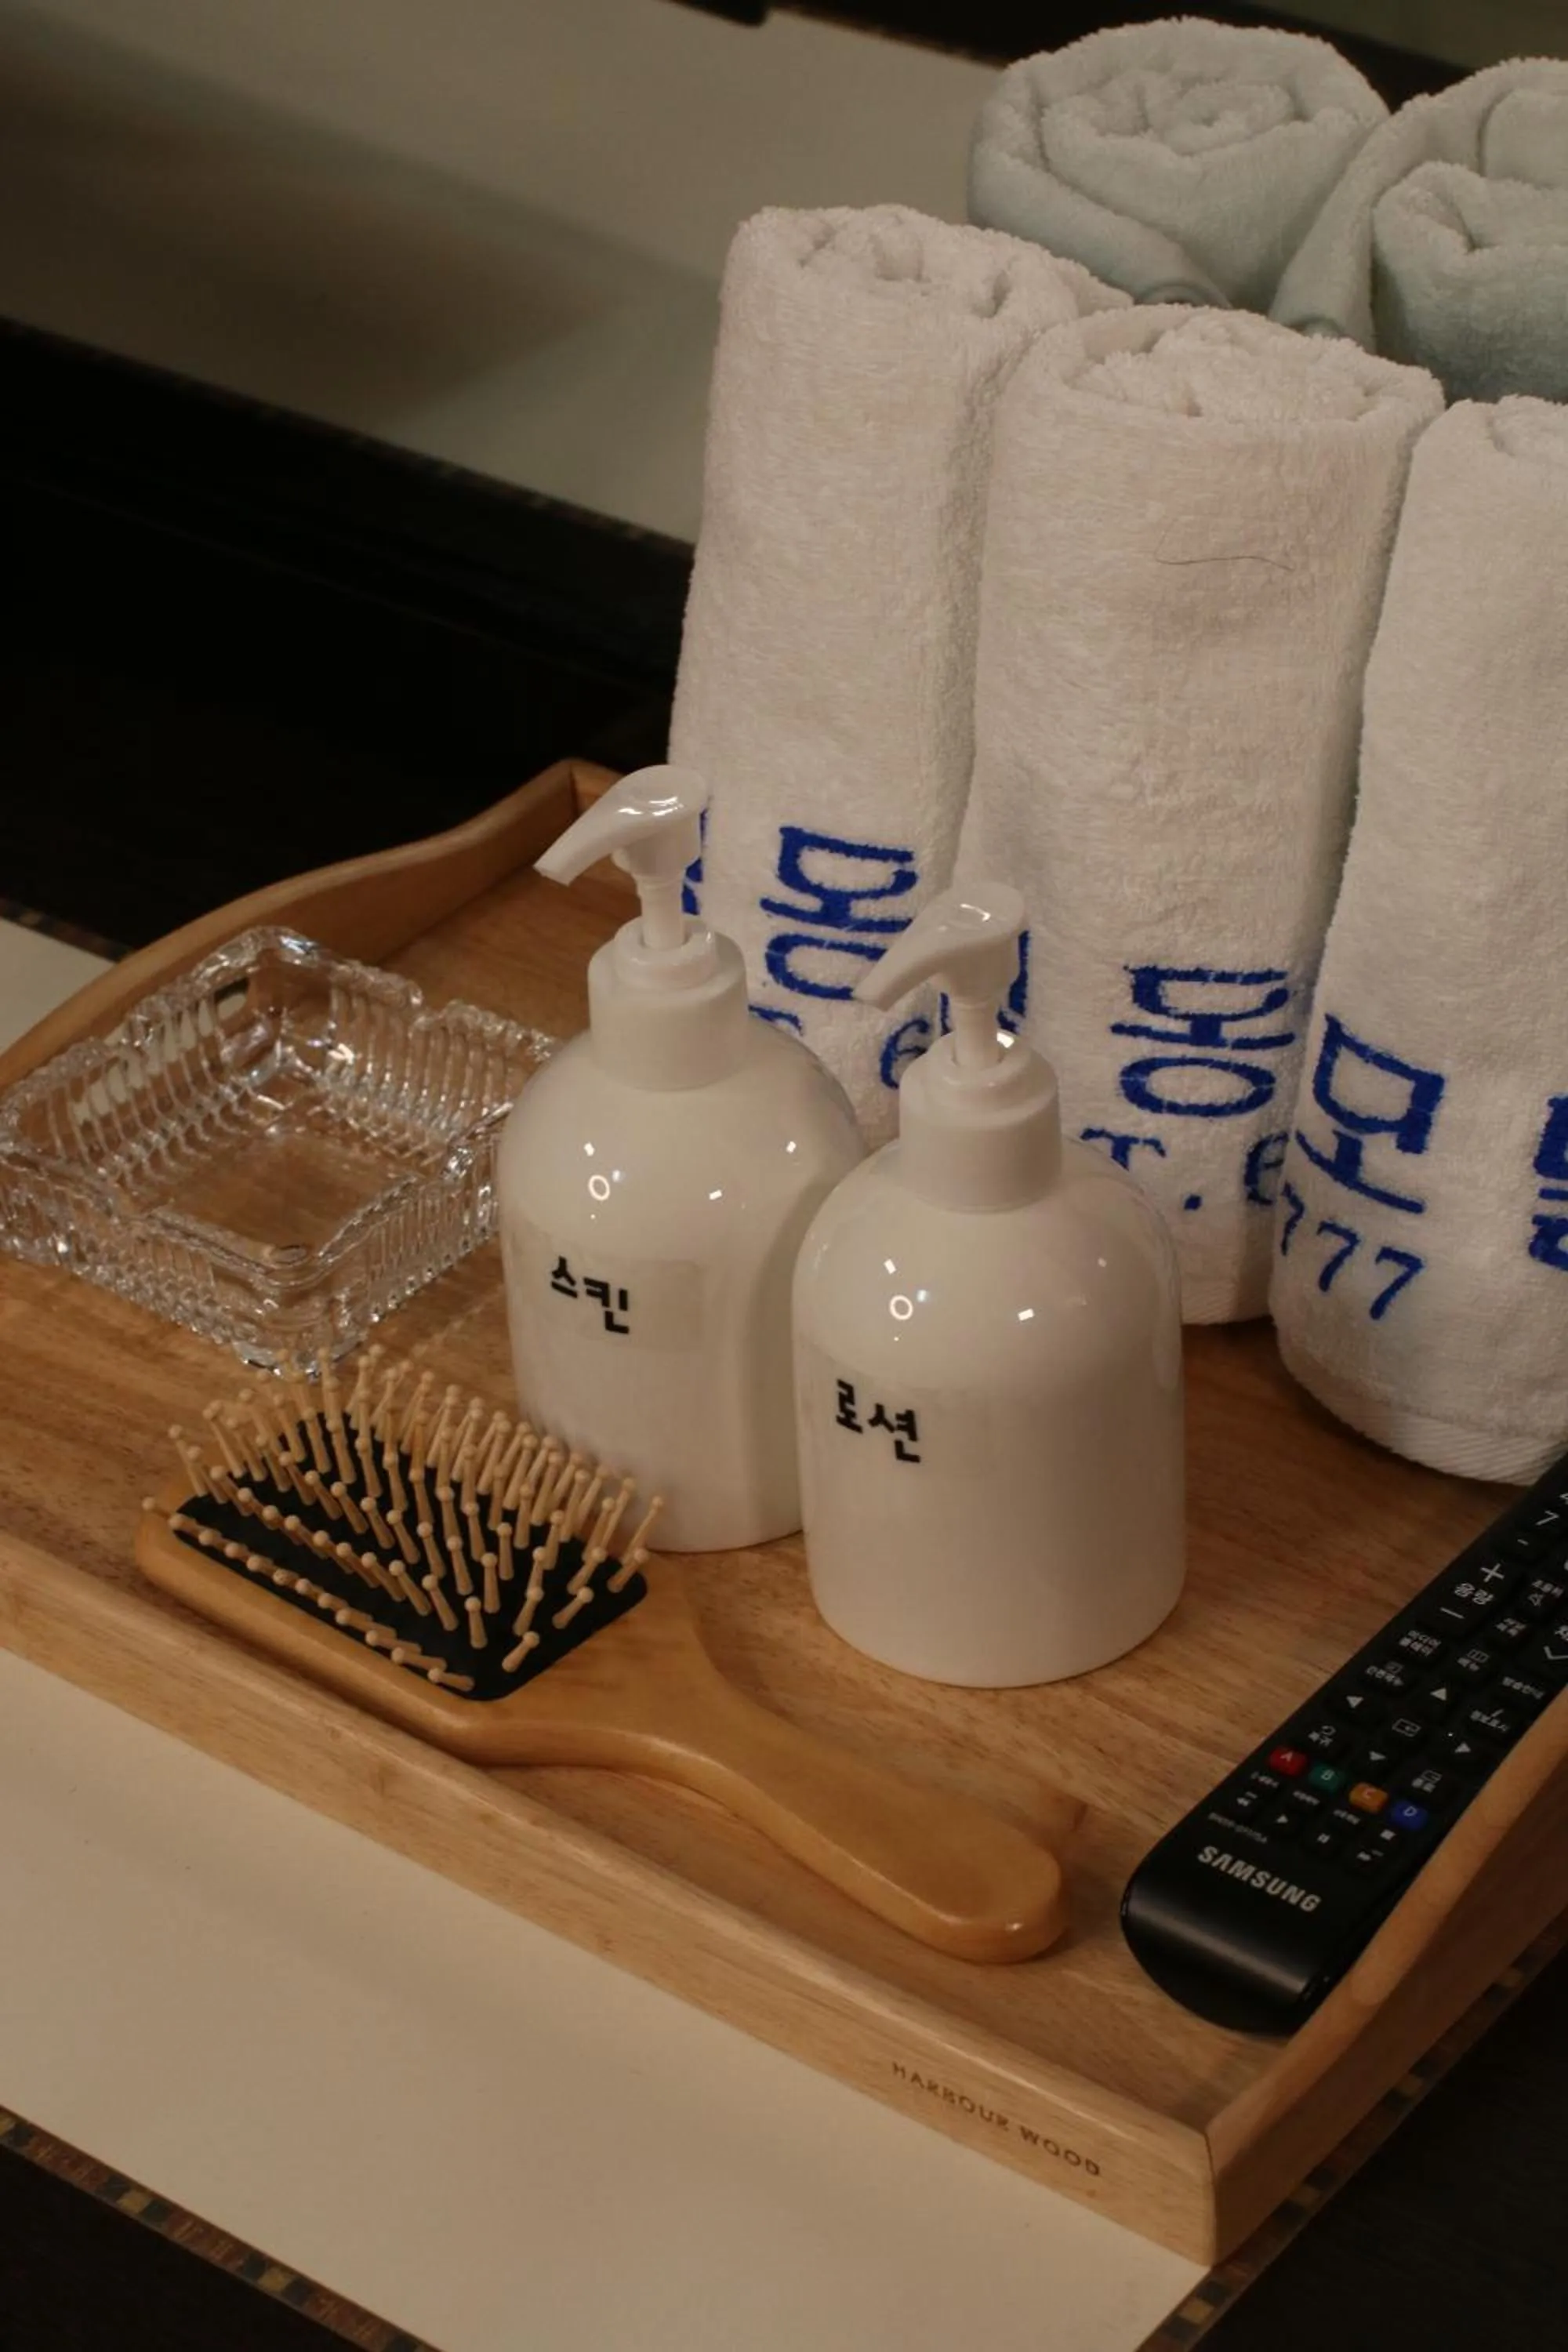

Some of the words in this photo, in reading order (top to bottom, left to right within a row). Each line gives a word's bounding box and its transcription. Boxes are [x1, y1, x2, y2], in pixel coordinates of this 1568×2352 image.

[550, 1255, 630, 1334] 스킨
[836, 1378, 921, 1464] 로션
[1196, 1845, 1322, 1912] SAMSUNG
[891, 2060, 1010, 2132] HARBOUR
[1019, 2125, 1101, 2176] WOOD
